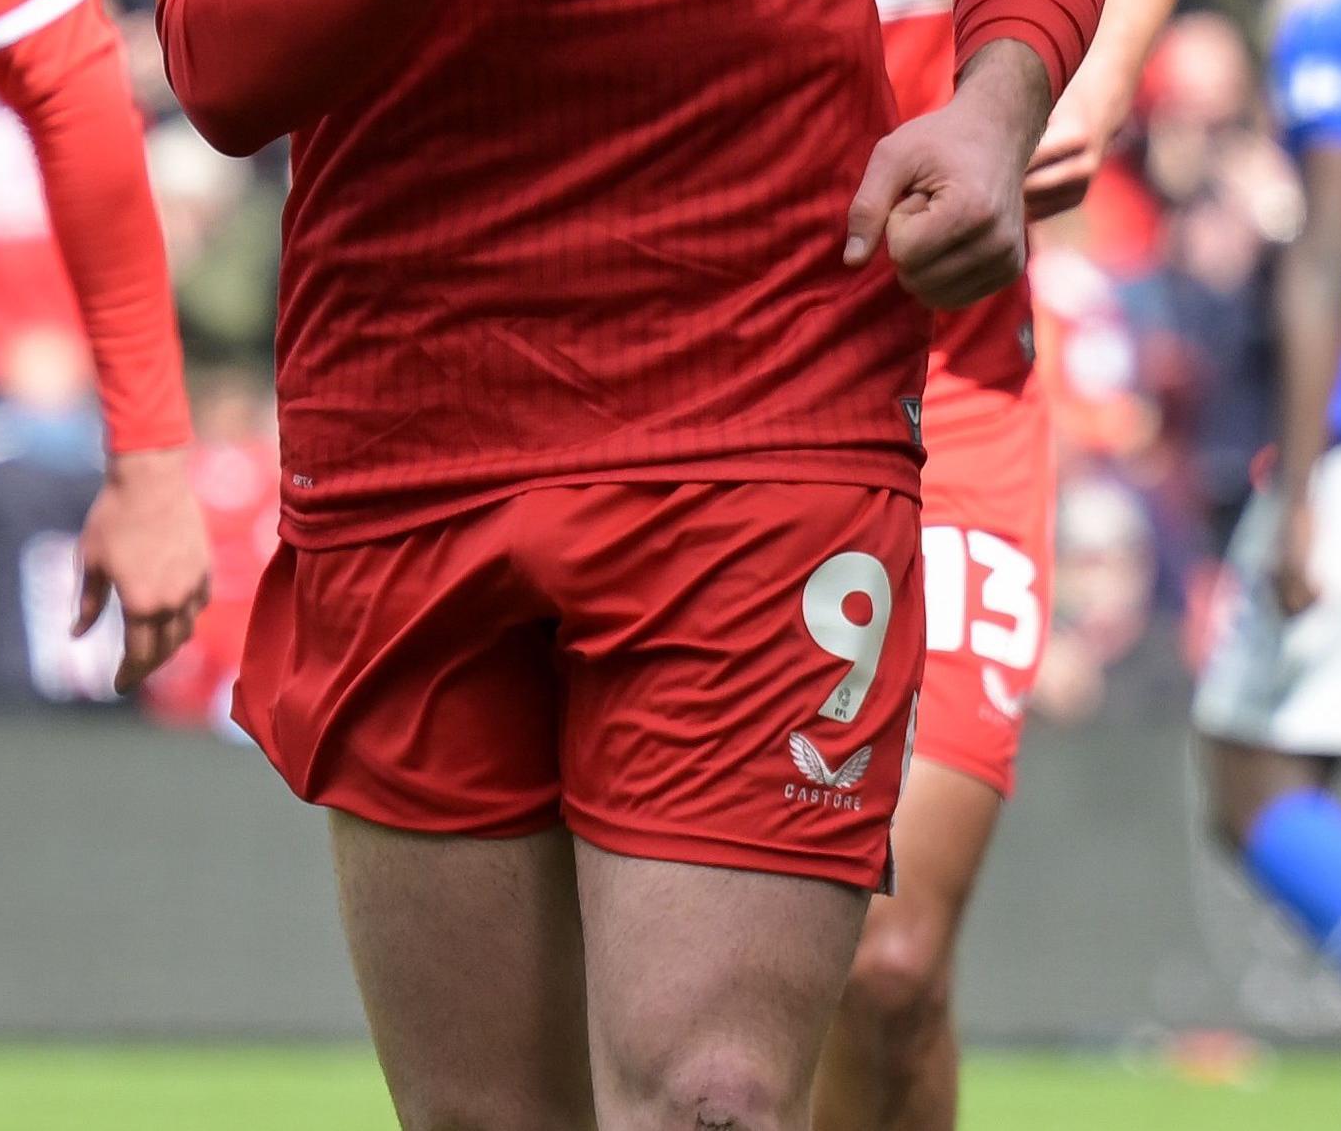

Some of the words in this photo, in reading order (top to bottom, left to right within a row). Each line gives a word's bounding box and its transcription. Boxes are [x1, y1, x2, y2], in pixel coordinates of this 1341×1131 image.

[802, 551, 893, 724] 9
[921, 525, 1040, 669] 13
[784, 783, 863, 812] CASTORE
